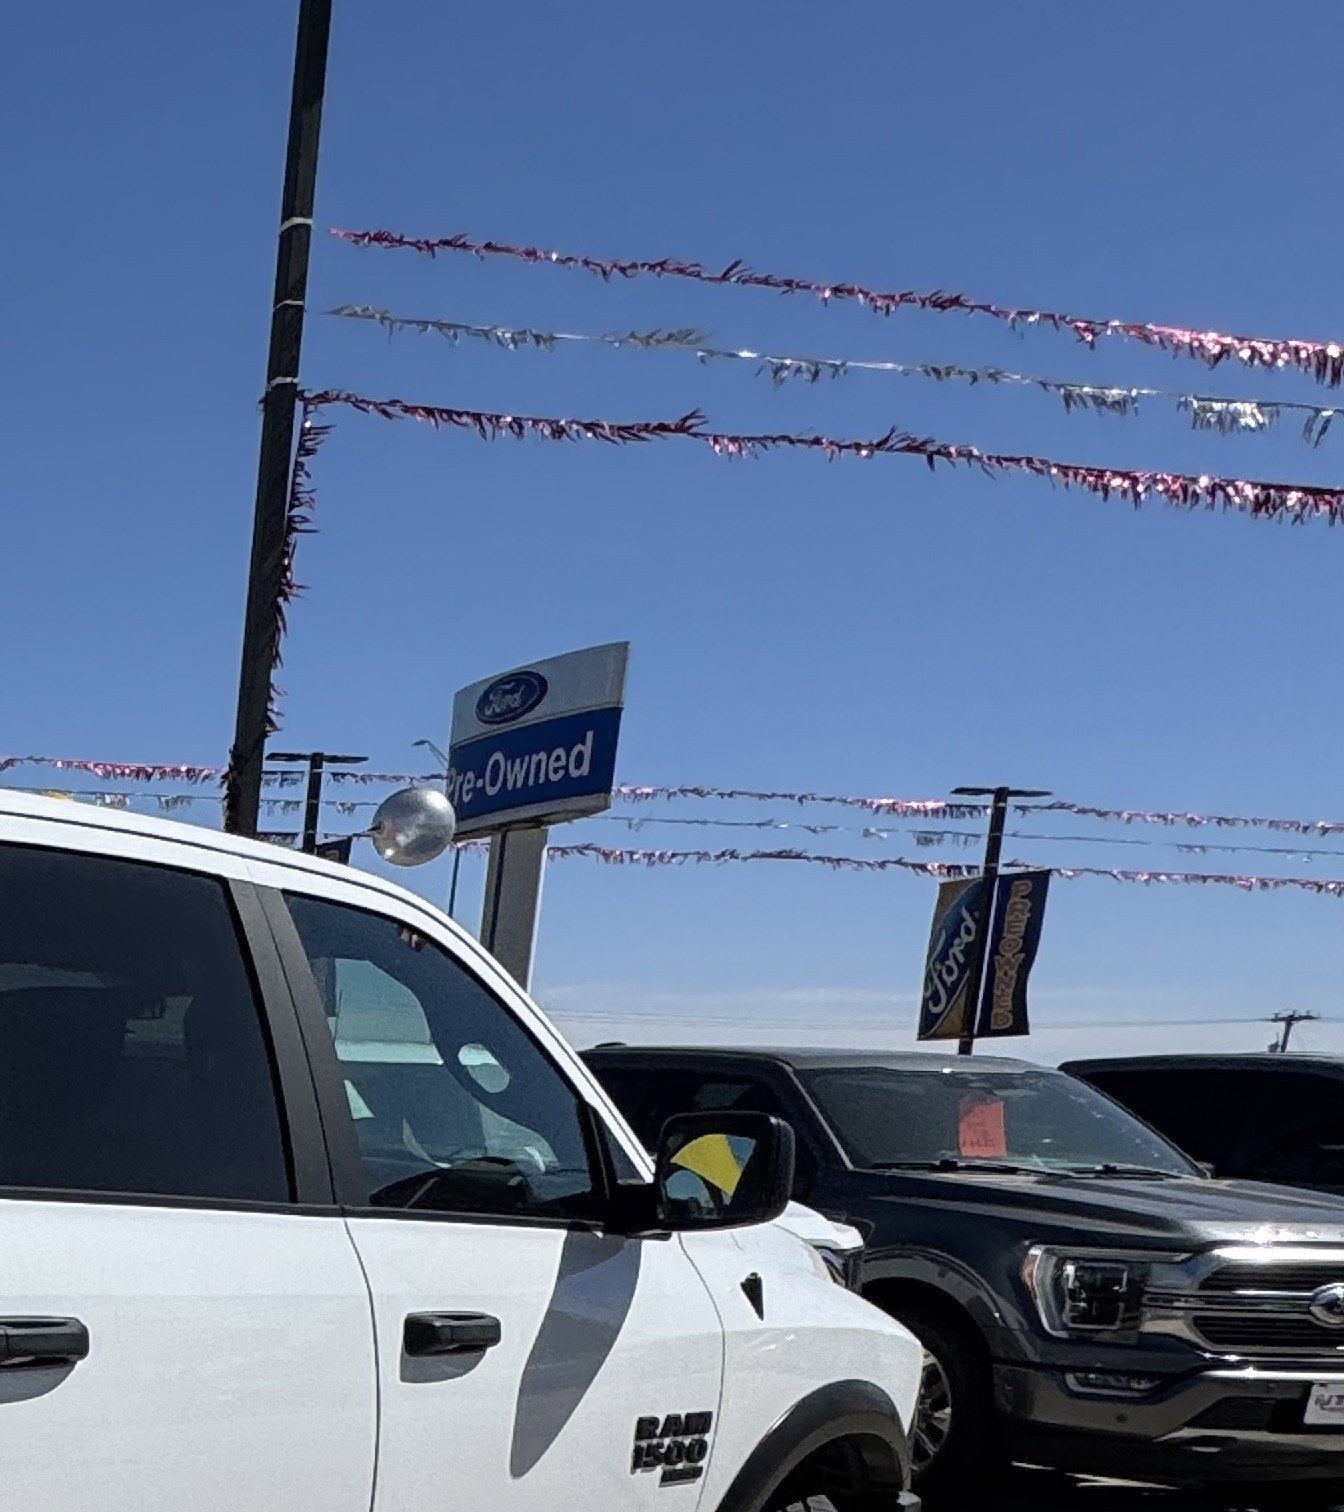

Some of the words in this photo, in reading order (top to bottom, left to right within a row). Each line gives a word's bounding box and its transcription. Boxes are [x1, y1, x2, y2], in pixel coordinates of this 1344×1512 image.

[484, 681, 526, 716] Ford
[923, 906, 979, 1014] Ford
[636, 1411, 712, 1439] RAM
[632, 1438, 708, 1470] 1500
